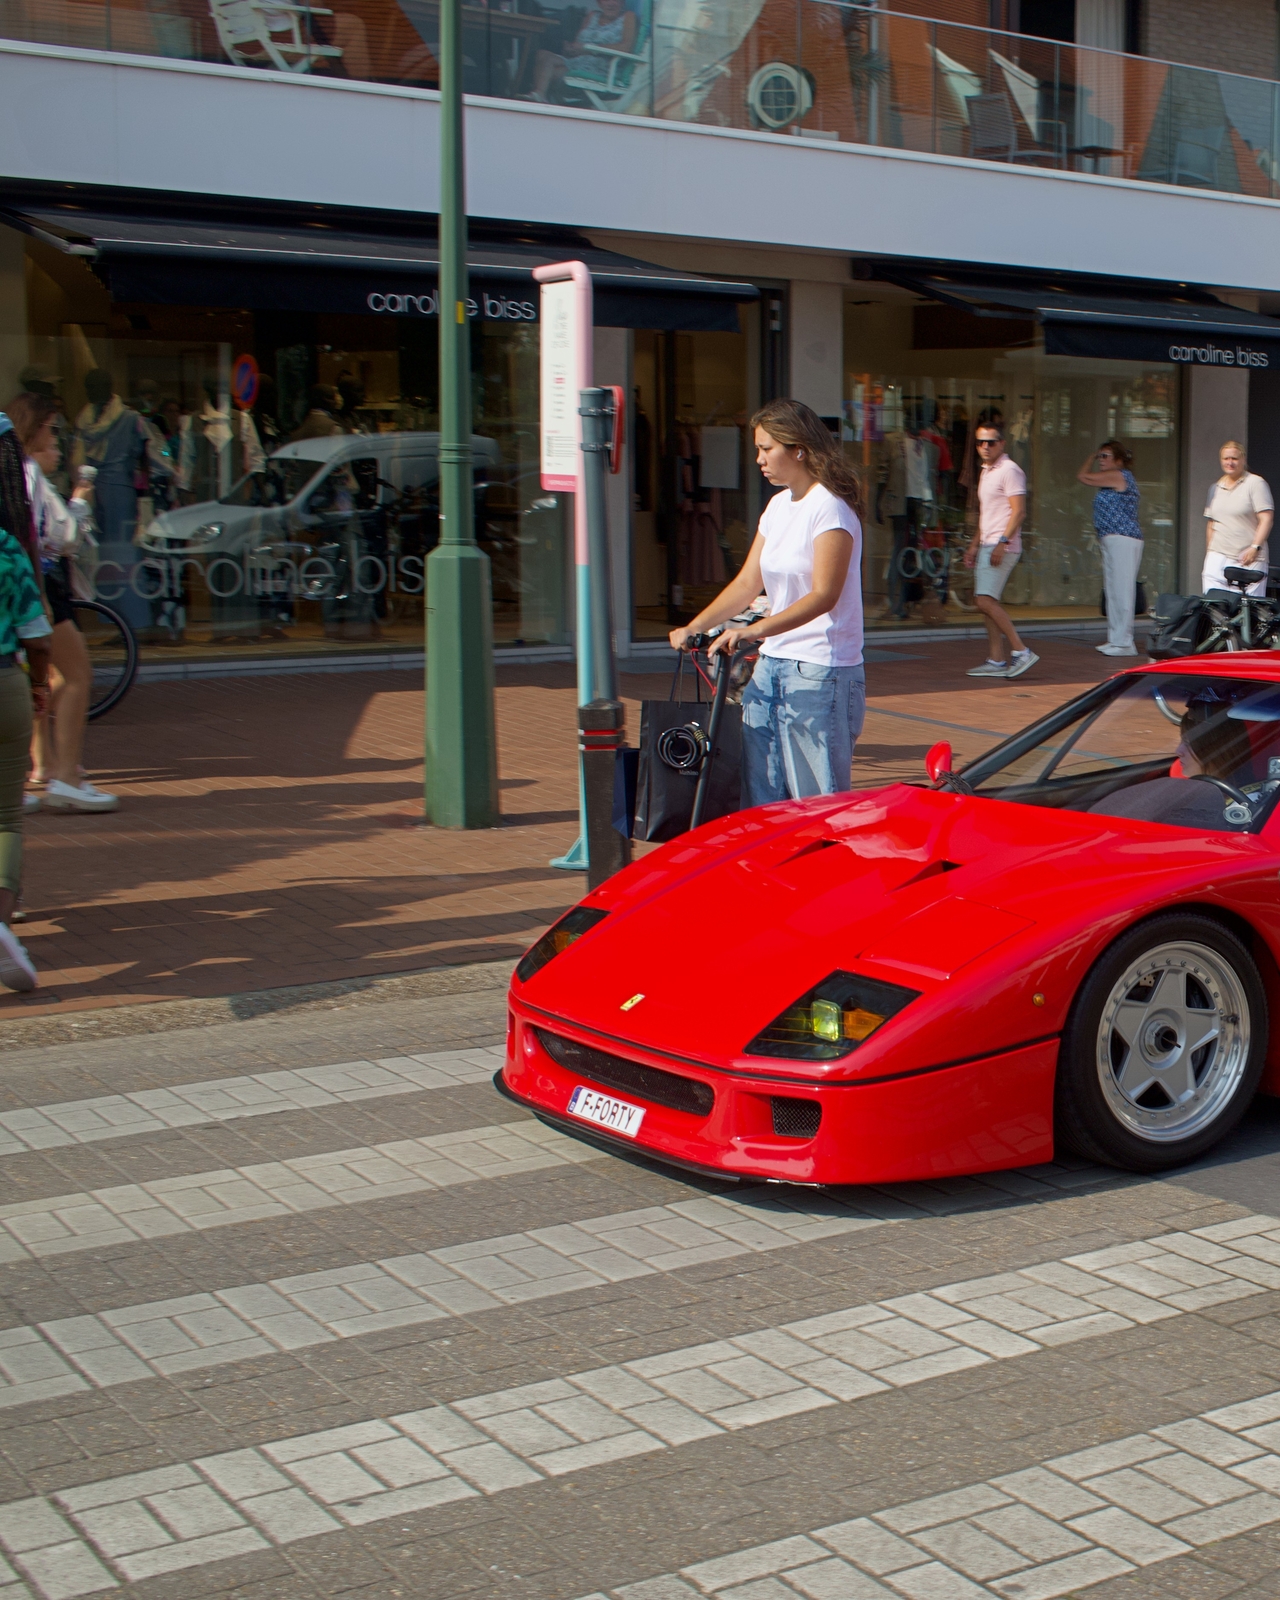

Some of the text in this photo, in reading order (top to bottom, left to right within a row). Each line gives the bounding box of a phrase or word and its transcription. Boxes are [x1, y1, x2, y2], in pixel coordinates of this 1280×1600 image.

[367, 289, 537, 320] carole biss
[1168, 343, 1269, 367] caroline biss
[92, 538, 427, 600] caroline bis
